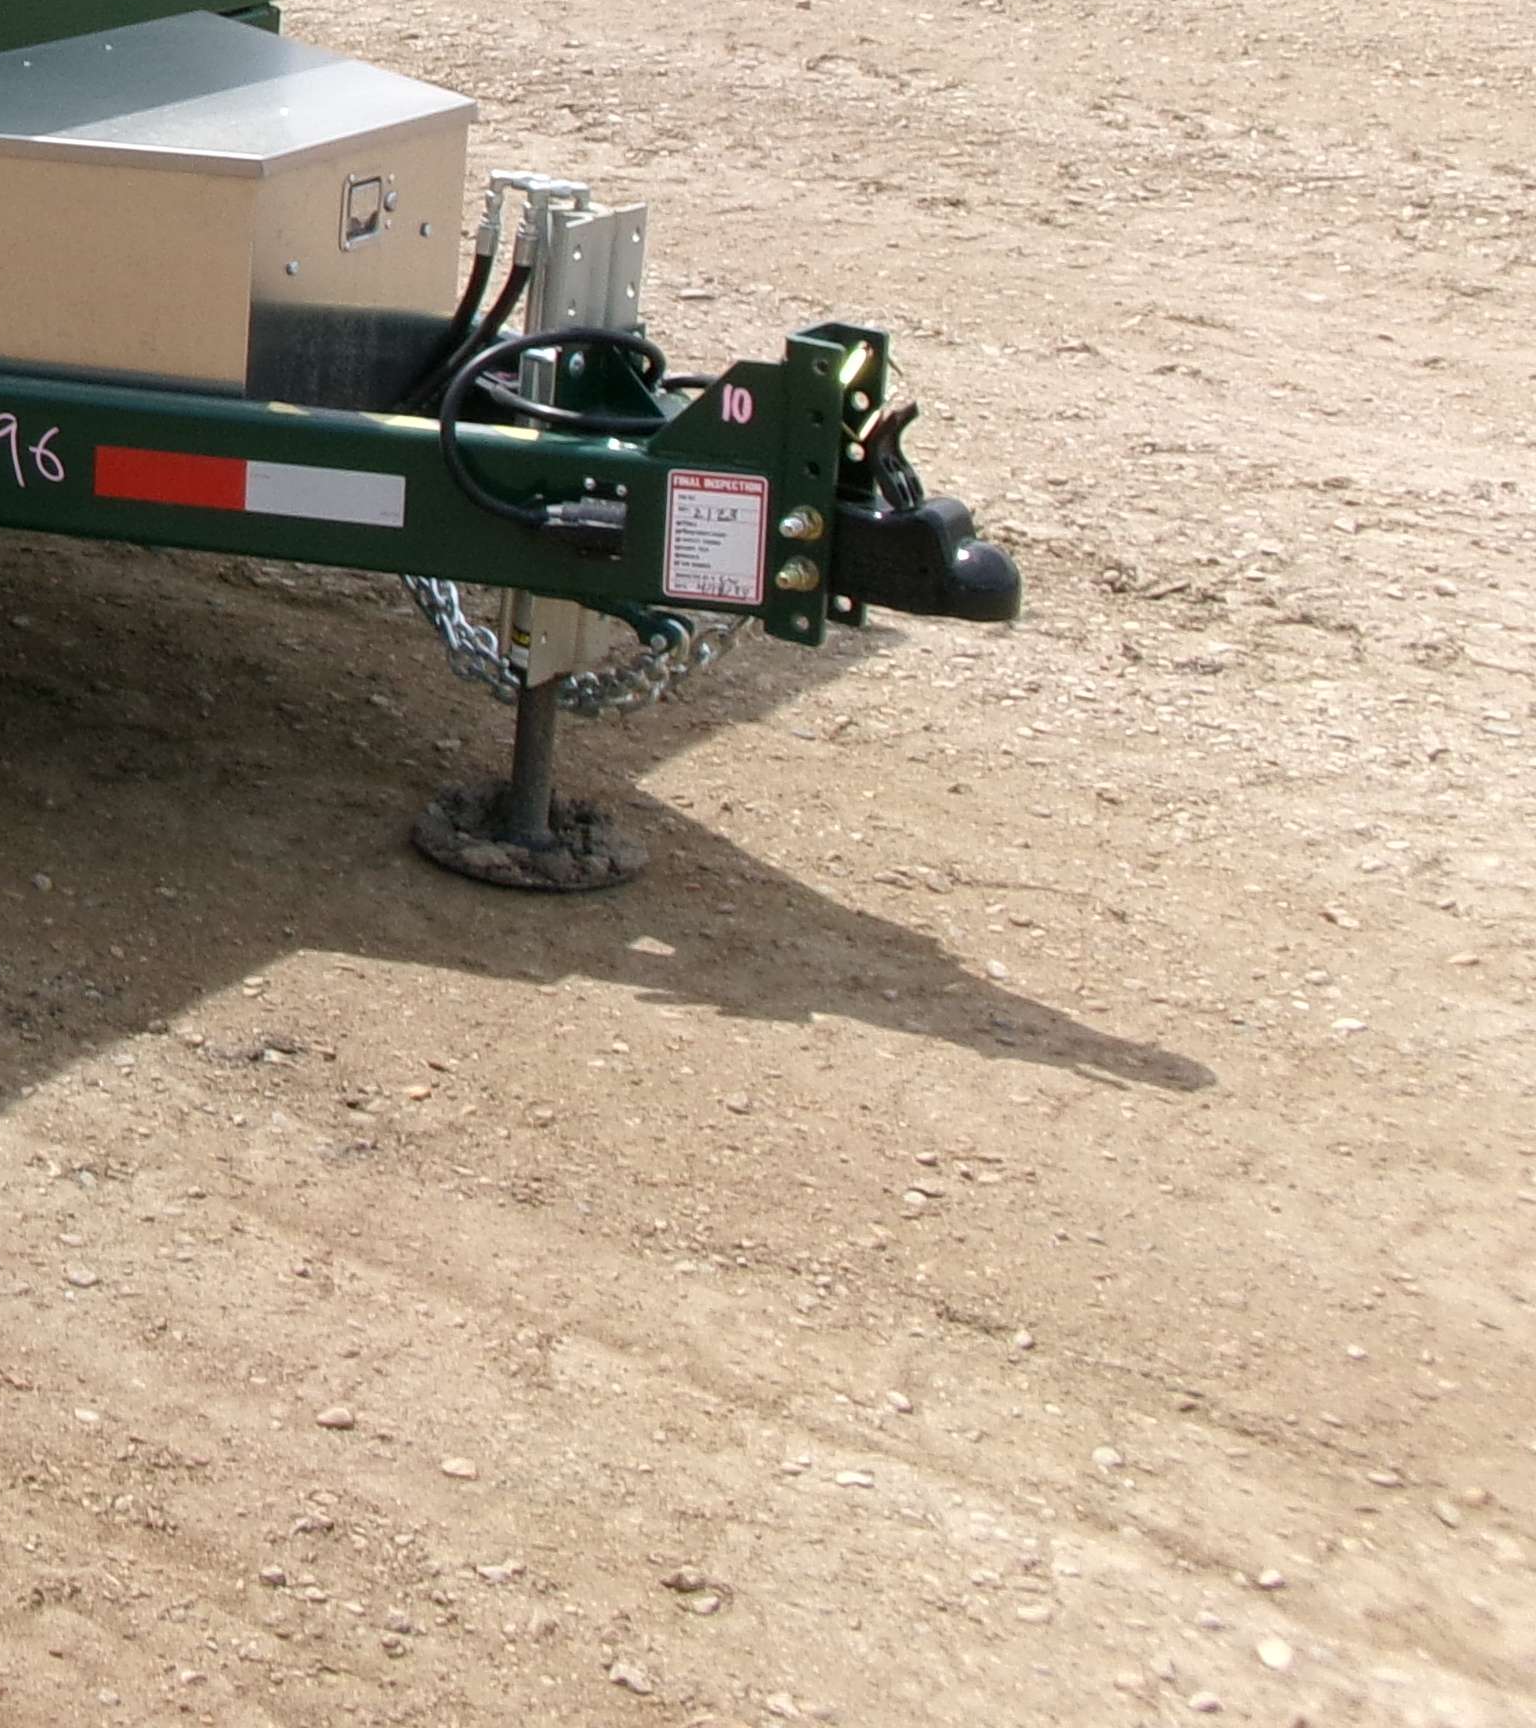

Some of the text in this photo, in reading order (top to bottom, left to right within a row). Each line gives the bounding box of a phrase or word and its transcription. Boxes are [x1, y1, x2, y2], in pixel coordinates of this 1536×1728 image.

[722, 383, 752, 423] 10
[673, 475, 763, 493] FINAL INSPECTION
